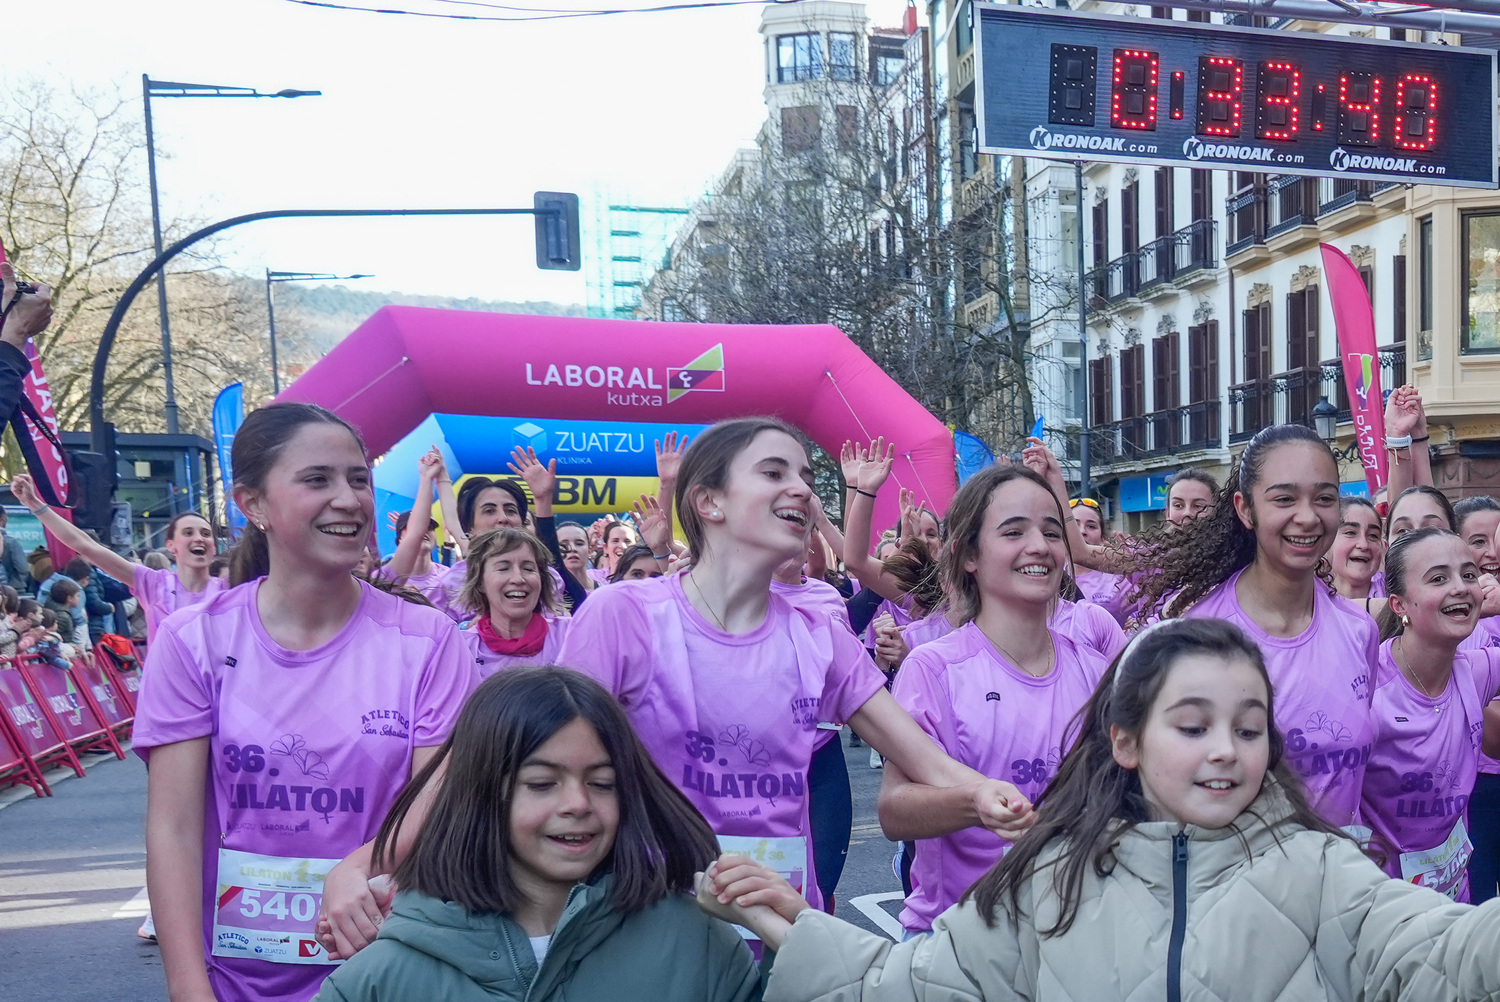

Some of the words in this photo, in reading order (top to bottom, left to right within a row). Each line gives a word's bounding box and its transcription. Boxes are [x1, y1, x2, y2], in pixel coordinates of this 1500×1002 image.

[525, 362, 663, 390] LABORAL
[607, 391, 663, 408] kutxa
[554, 431, 645, 454] ZUATZU
[557, 457, 593, 466] KLINIKA
[554, 477, 617, 507] BM
[361, 709, 410, 730] ATLETICO
[361, 723, 377, 736] San
[1285, 728, 1319, 752] 6.
[223, 743, 281, 777] 36.
[682, 764, 805, 808] LILATON
[1396, 795, 1470, 818] LILATO
[240, 866, 293, 882] LILATON
[240, 888, 323, 922] 540
[217, 932, 250, 945] ATLETICO
